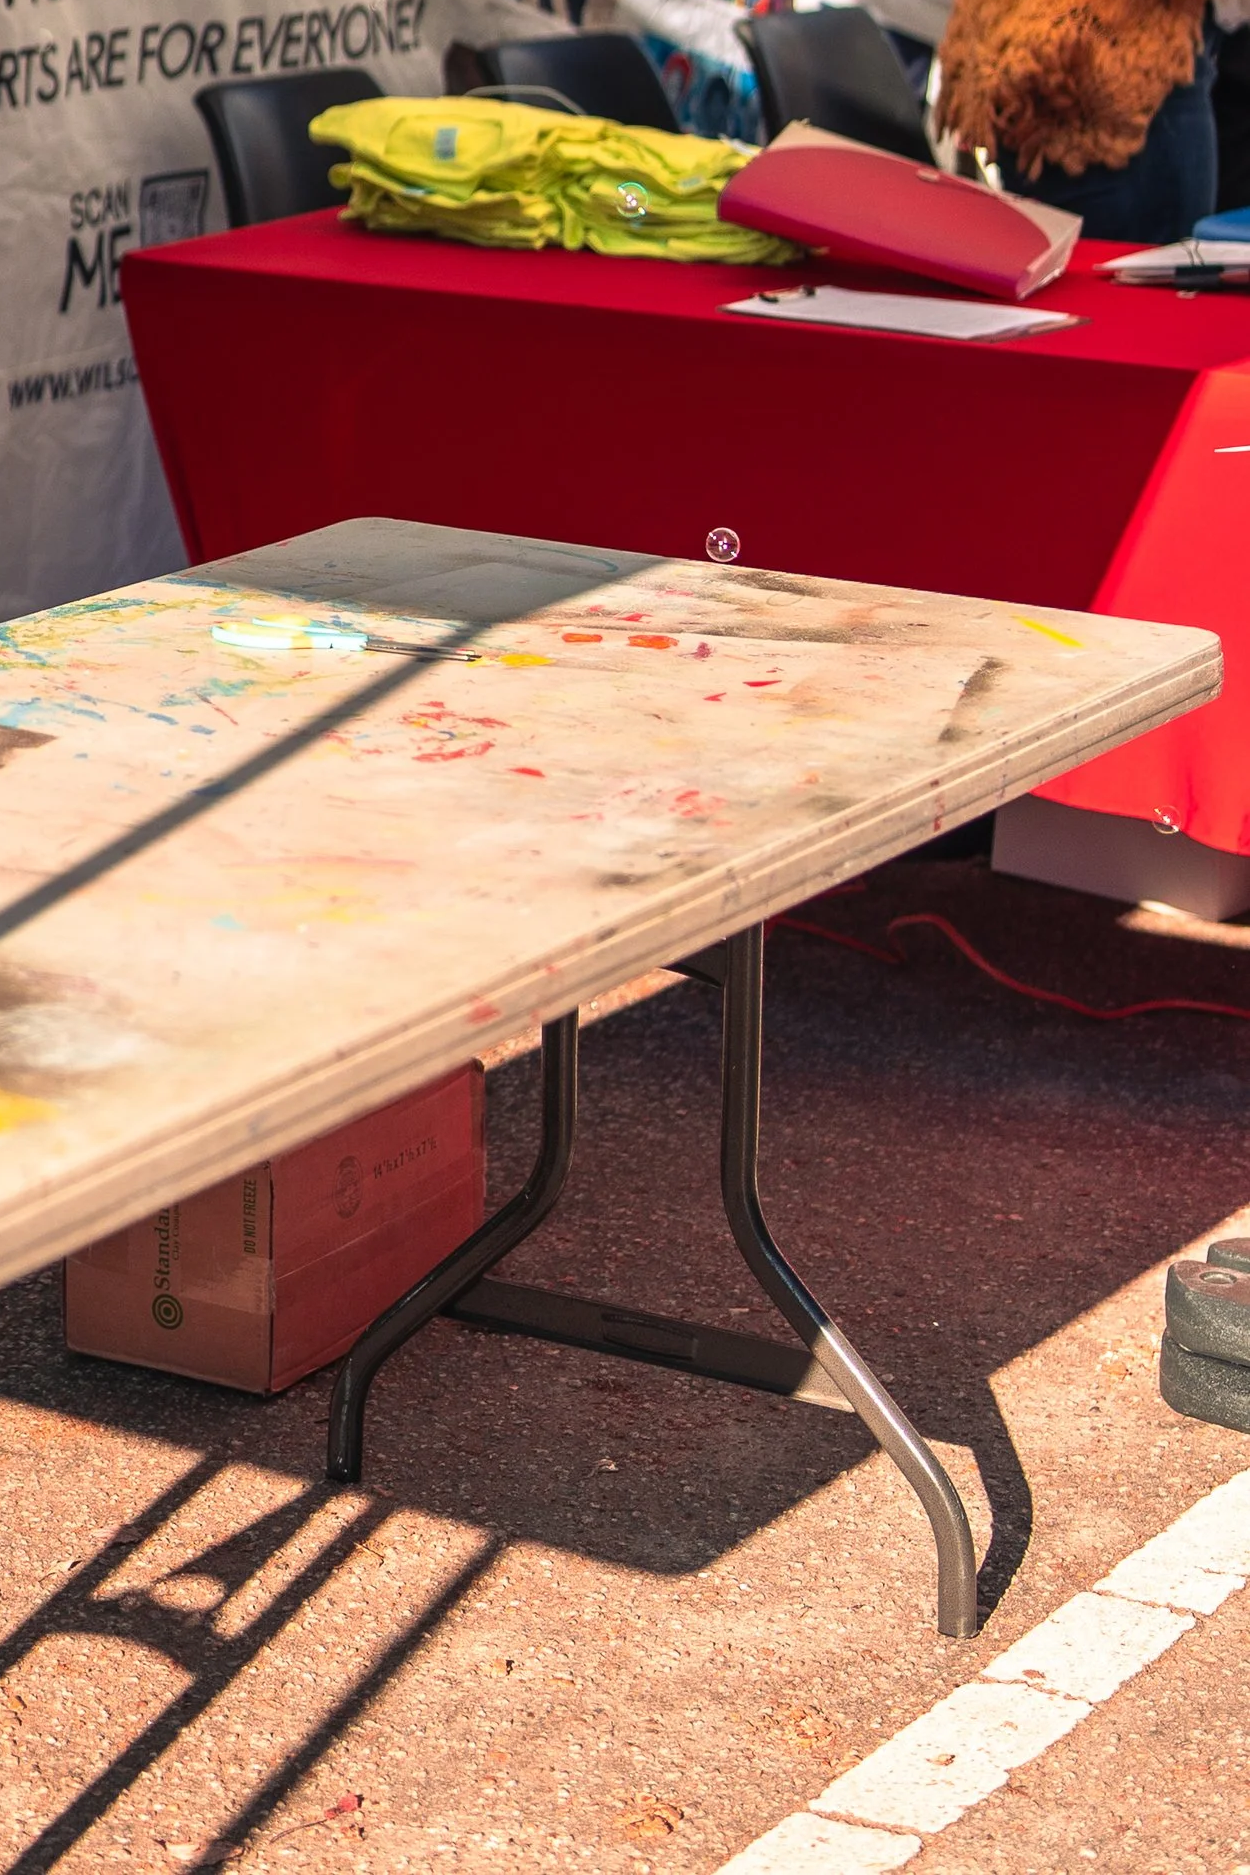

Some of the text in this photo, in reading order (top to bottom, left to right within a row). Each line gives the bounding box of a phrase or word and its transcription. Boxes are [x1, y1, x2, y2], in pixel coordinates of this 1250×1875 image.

[64, 27, 132, 98] ARE
[137, 20, 227, 83] FOR
[68, 179, 132, 231] SCAN
[58, 224, 132, 315] ME
[243, 1178, 258, 1255] DO NOT FREEZE
